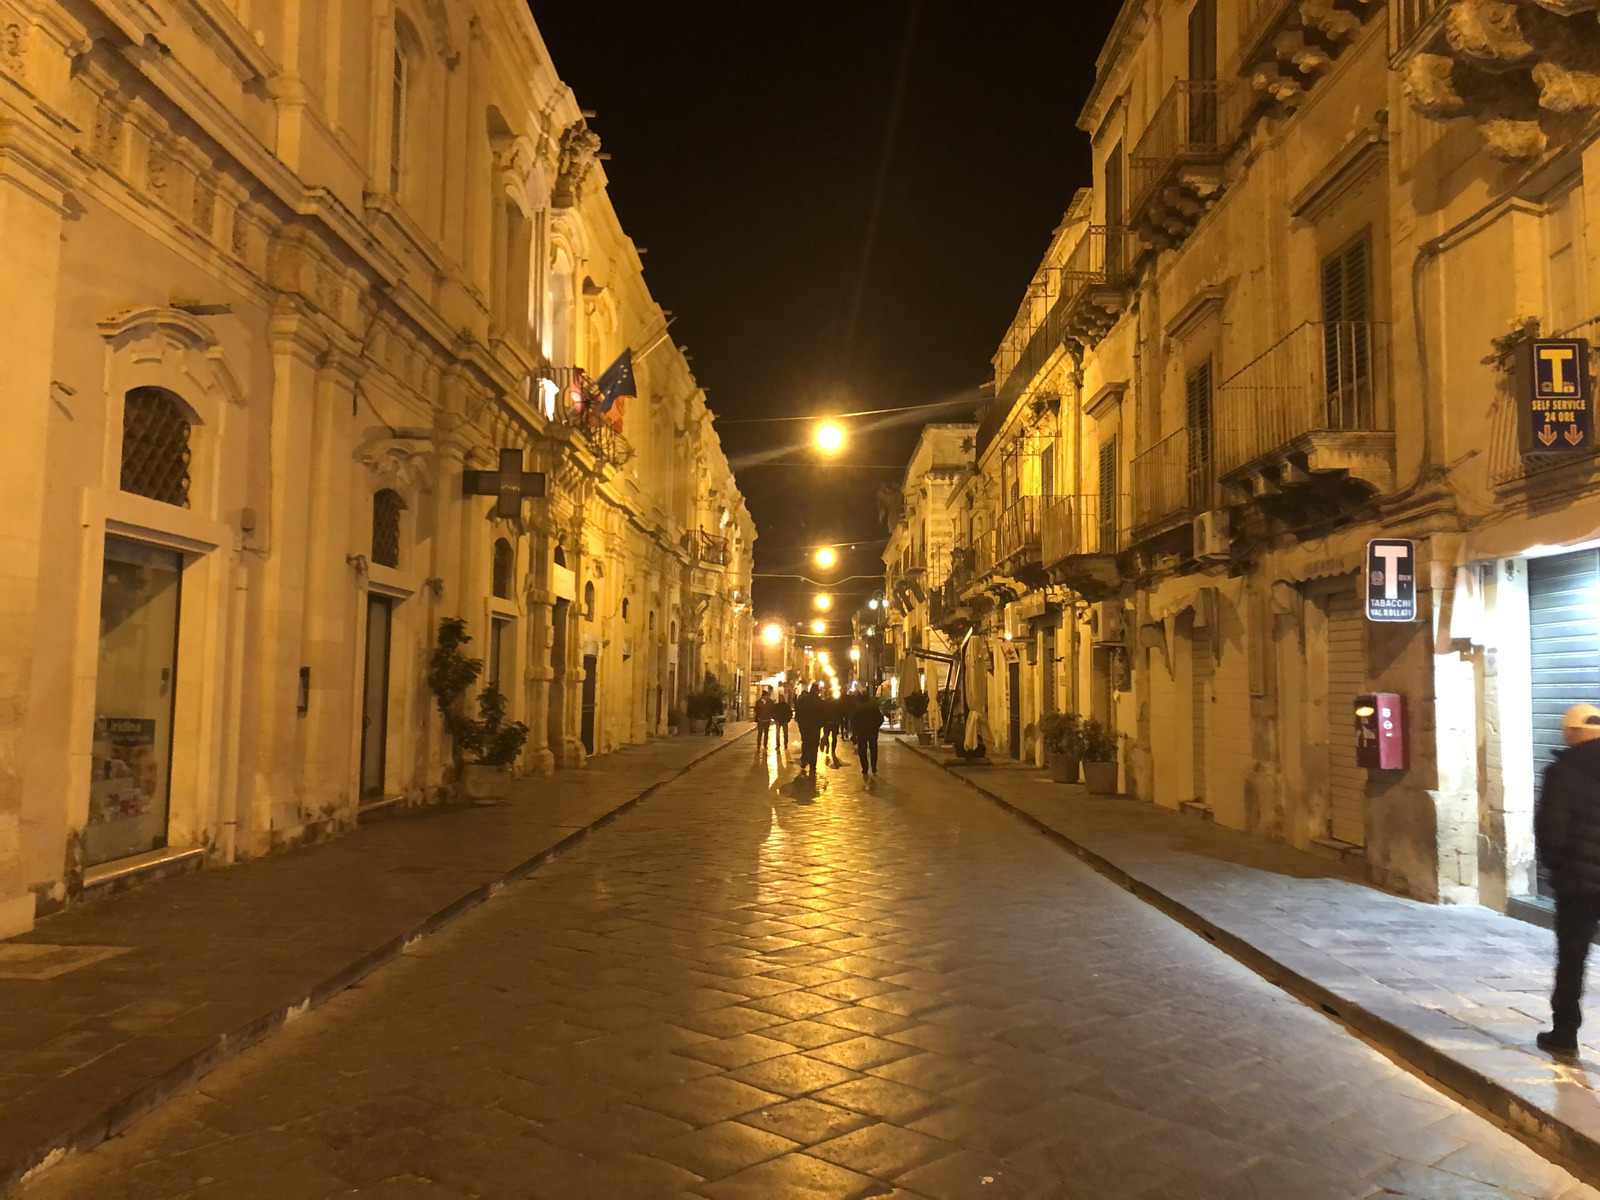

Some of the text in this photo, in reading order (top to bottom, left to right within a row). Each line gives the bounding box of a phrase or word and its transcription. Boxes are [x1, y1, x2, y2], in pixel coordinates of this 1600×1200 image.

[1540, 349, 1573, 393] T
[1532, 400, 1585, 410] SELF SERVICE
[1544, 412, 1575, 422] 24 ORE
[1374, 546, 1408, 599] T
[1371, 599, 1411, 607] TABACCHI
